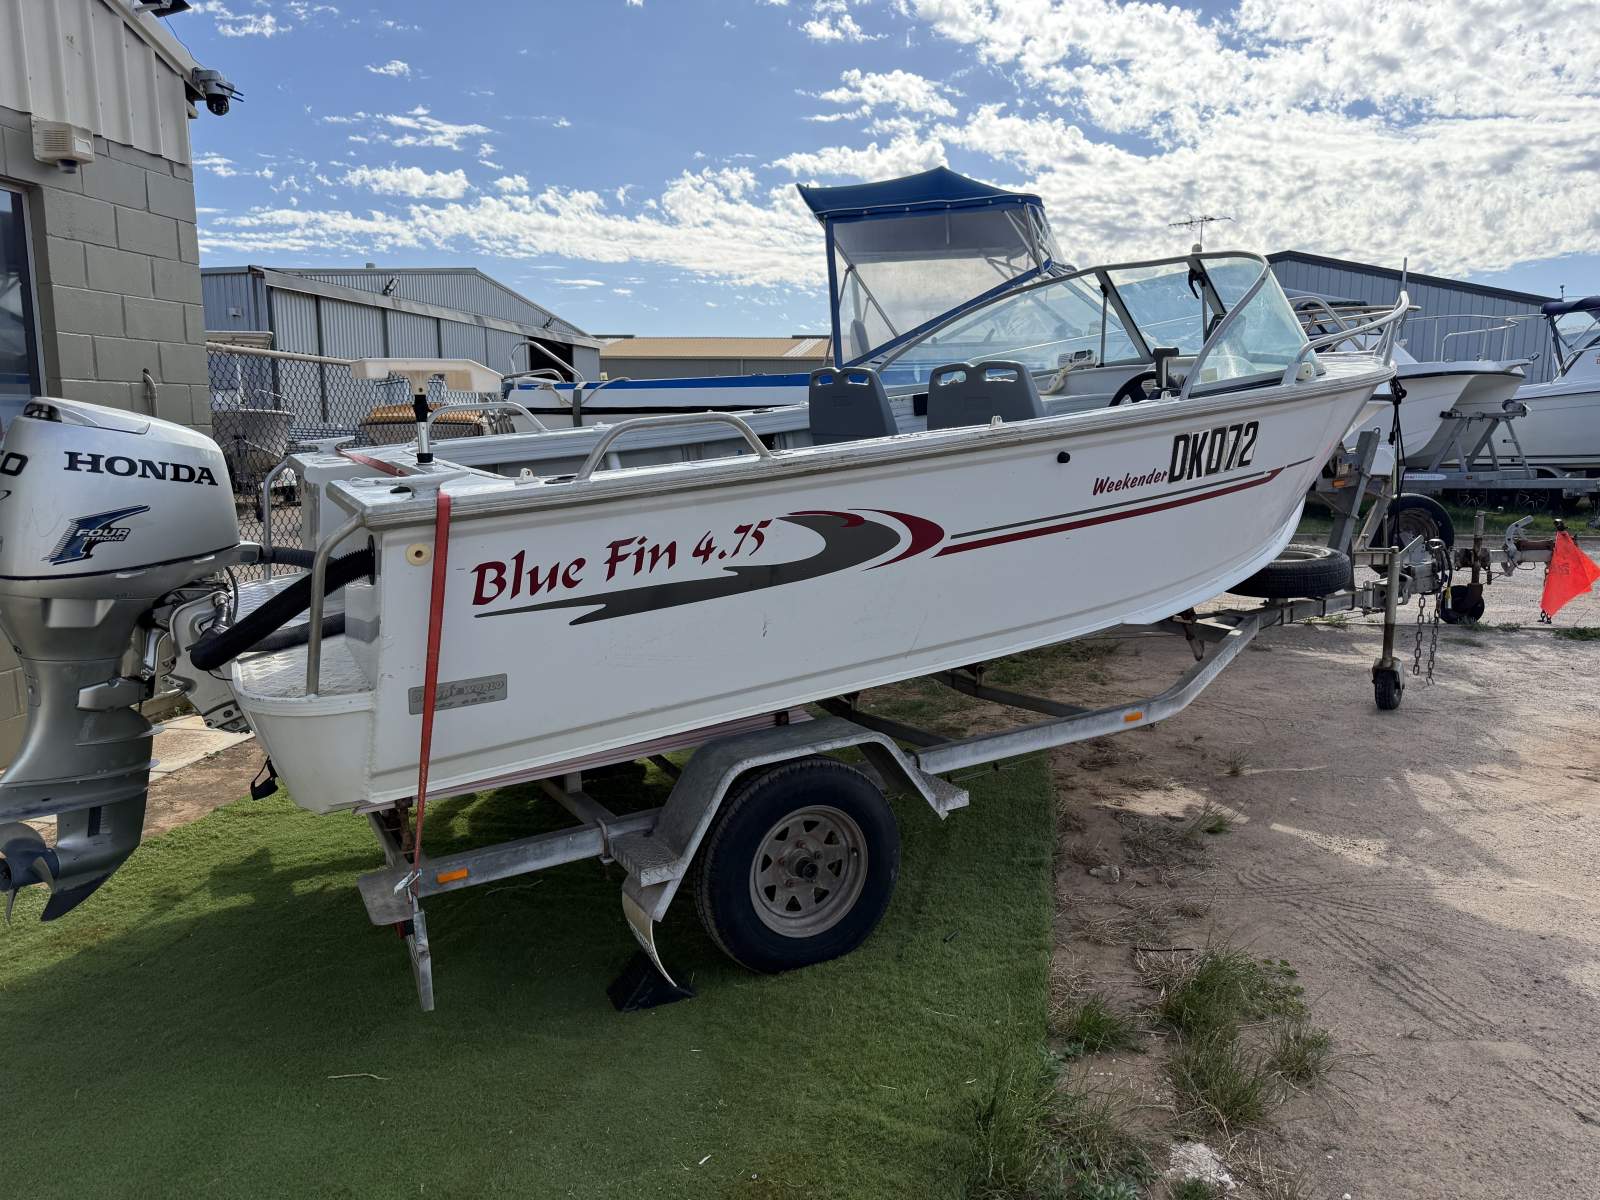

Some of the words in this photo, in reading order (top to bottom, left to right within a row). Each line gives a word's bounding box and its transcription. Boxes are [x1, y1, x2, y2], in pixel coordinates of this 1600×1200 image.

[63, 451, 219, 486] HONDA
[1092, 468, 1168, 496] Weekender
[76, 528, 129, 537] FOUR
[471, 550, 587, 606] Blue
[605, 535, 679, 582] Fin
[691, 519, 773, 566] 4.75
